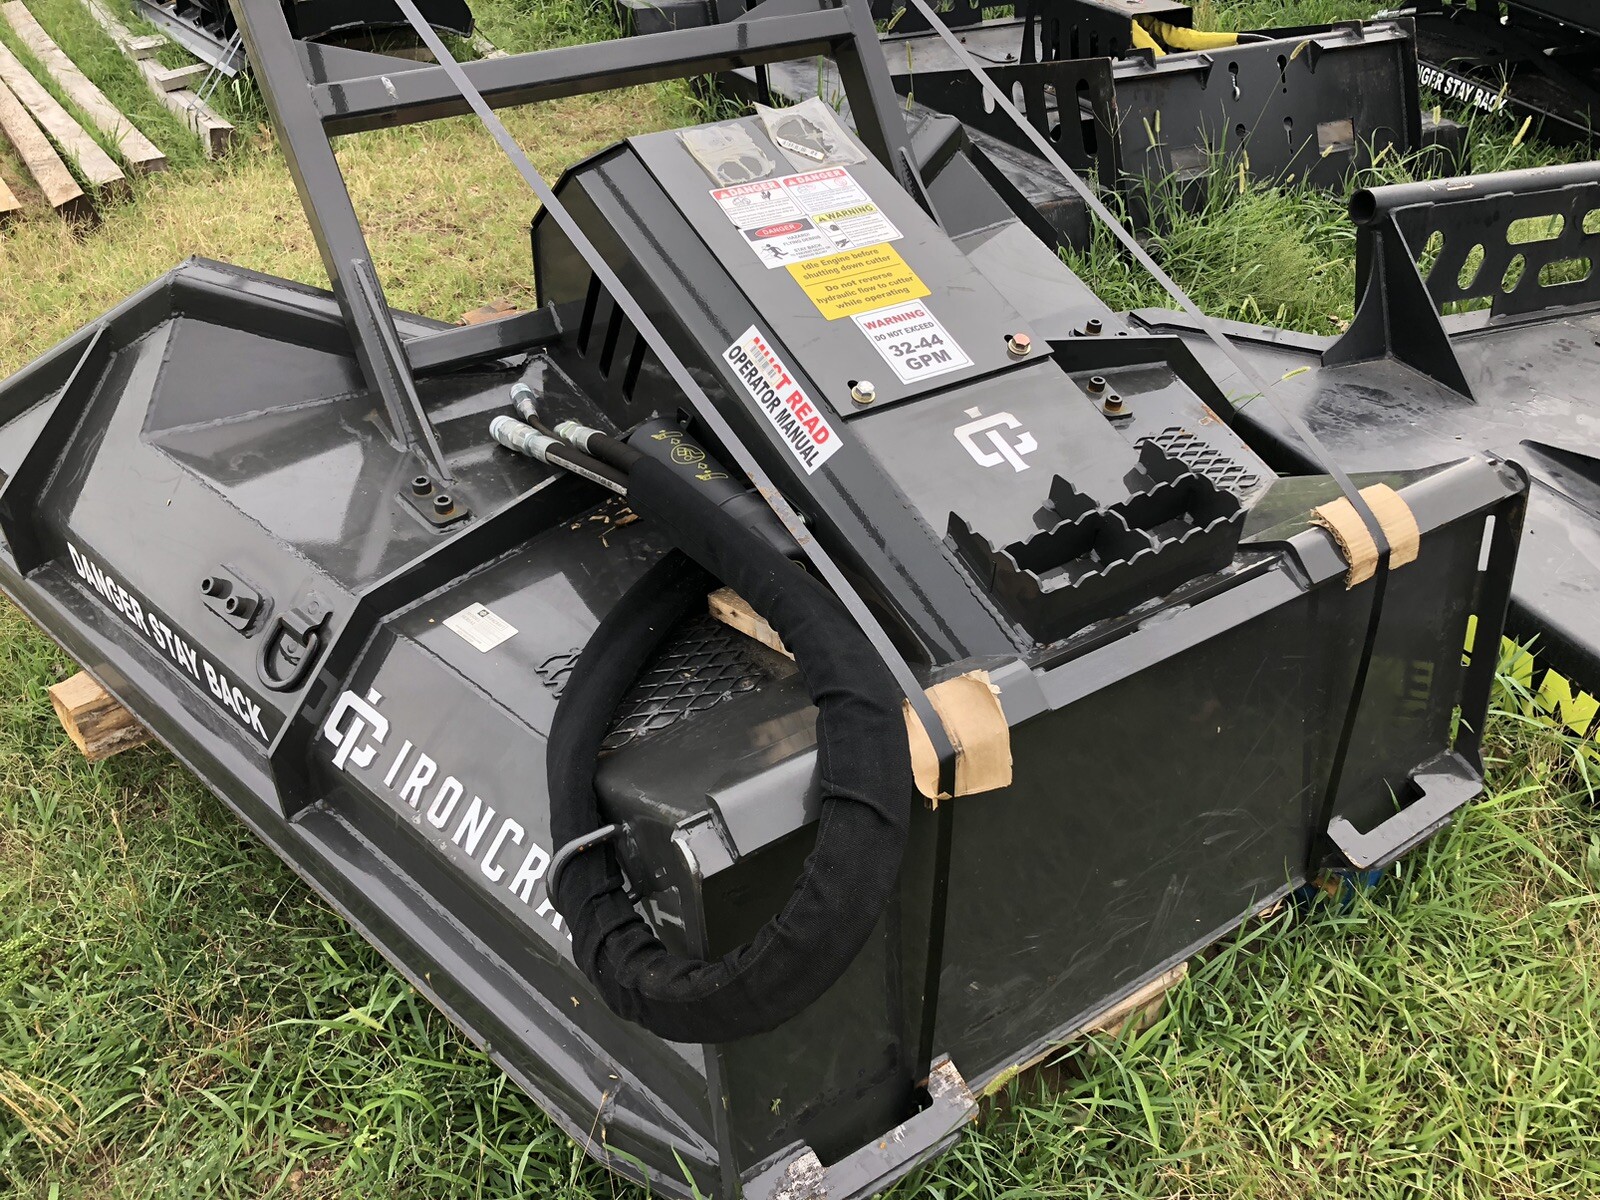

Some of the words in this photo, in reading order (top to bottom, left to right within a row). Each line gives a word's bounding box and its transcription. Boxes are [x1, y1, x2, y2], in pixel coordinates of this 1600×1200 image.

[1417, 64, 1445, 91] NGER
[1444, 76, 1475, 102] STAY
[1473, 88, 1508, 117] BACK
[798, 169, 842, 185] DANGER
[728, 180, 777, 198] DANGER
[826, 204, 874, 220] WARNING
[761, 224, 796, 235] DANGER
[801, 262, 819, 271] Idle
[820, 254, 851, 268] Engine
[851, 249, 880, 260] before
[803, 266, 841, 280] shutting
[840, 260, 865, 272] down
[866, 254, 892, 266] cutter
[816, 290, 857, 305] hydraulic
[857, 284, 877, 295] flow
[877, 281, 887, 291] to
[888, 275, 914, 287] cutter
[824, 283, 840, 292] Do
[840, 279, 857, 289] not
[858, 271, 893, 284] reverse
[836, 297, 863, 310] while
[864, 287, 911, 303] operating
[863, 309, 926, 331] WARNING
[874, 333, 887, 342] DO
[888, 329, 904, 339] NOT
[904, 321, 936, 335] EXCEED
[888, 333, 944, 358] 32-44
[905, 349, 952, 371] GPM
[728, 345, 781, 414] OPERATOR
[774, 407, 820, 468] MANUAL
[785, 390, 830, 445] READ
[67, 541, 151, 637] DANGER
[148, 612, 201, 681] STAY
[202, 658, 270, 742] BACK
[383, 739, 574, 942] IRONCR
